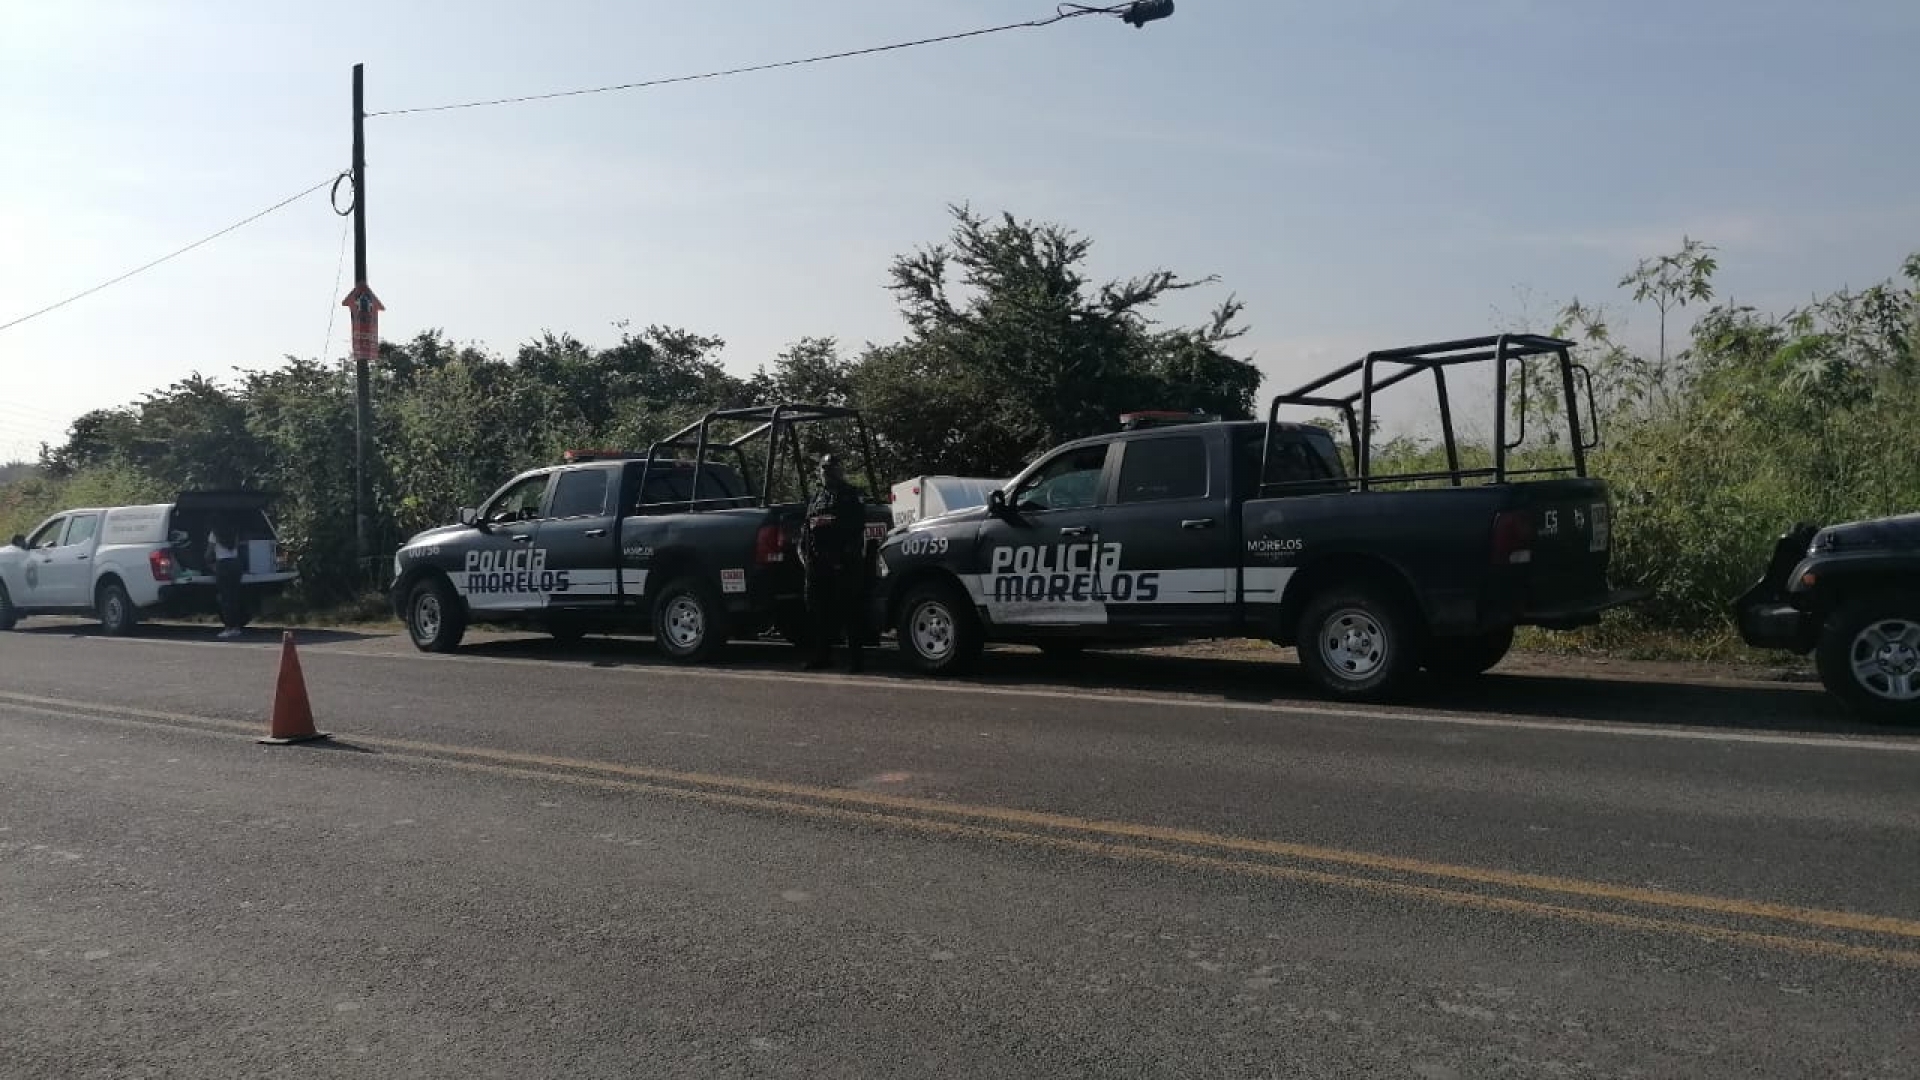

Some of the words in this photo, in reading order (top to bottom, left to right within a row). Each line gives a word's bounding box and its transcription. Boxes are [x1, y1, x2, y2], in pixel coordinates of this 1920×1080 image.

[901, 537, 949, 555] 00759
[1247, 539, 1303, 551] MORELOS
[467, 571, 569, 594] MORELOS
[995, 572, 1160, 601] MORELOS
